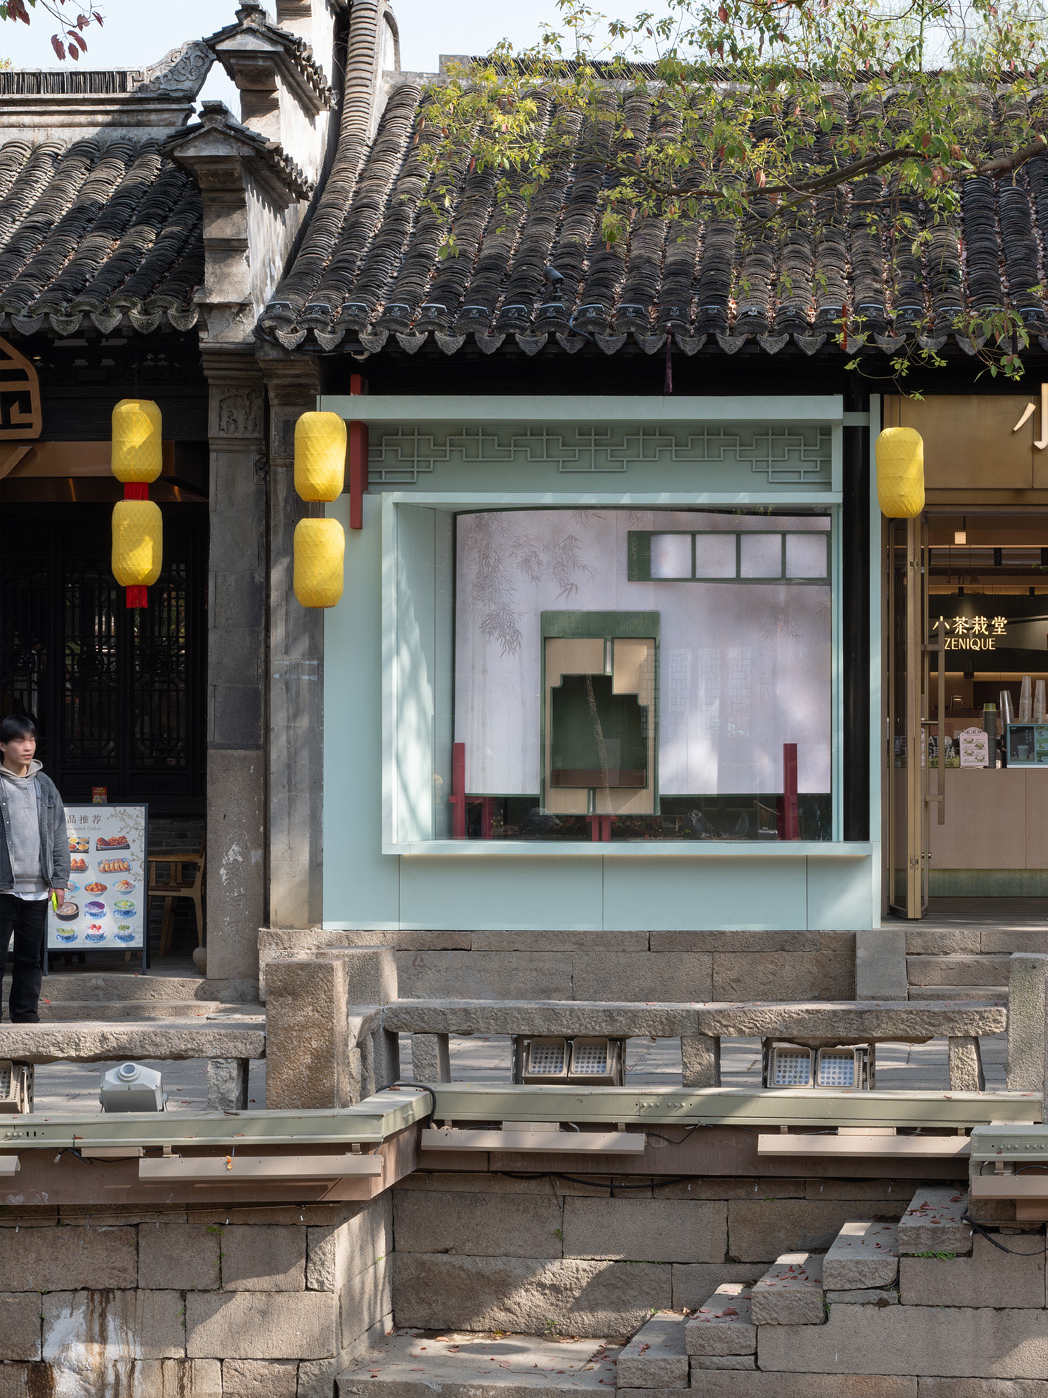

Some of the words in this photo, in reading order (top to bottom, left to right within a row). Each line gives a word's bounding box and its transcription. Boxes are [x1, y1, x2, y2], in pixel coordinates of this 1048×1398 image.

[932, 615, 1008, 635] 小茶栽堂
[944, 637, 996, 650] ZENIQUE
[67, 814, 102, 824] 品推荐
